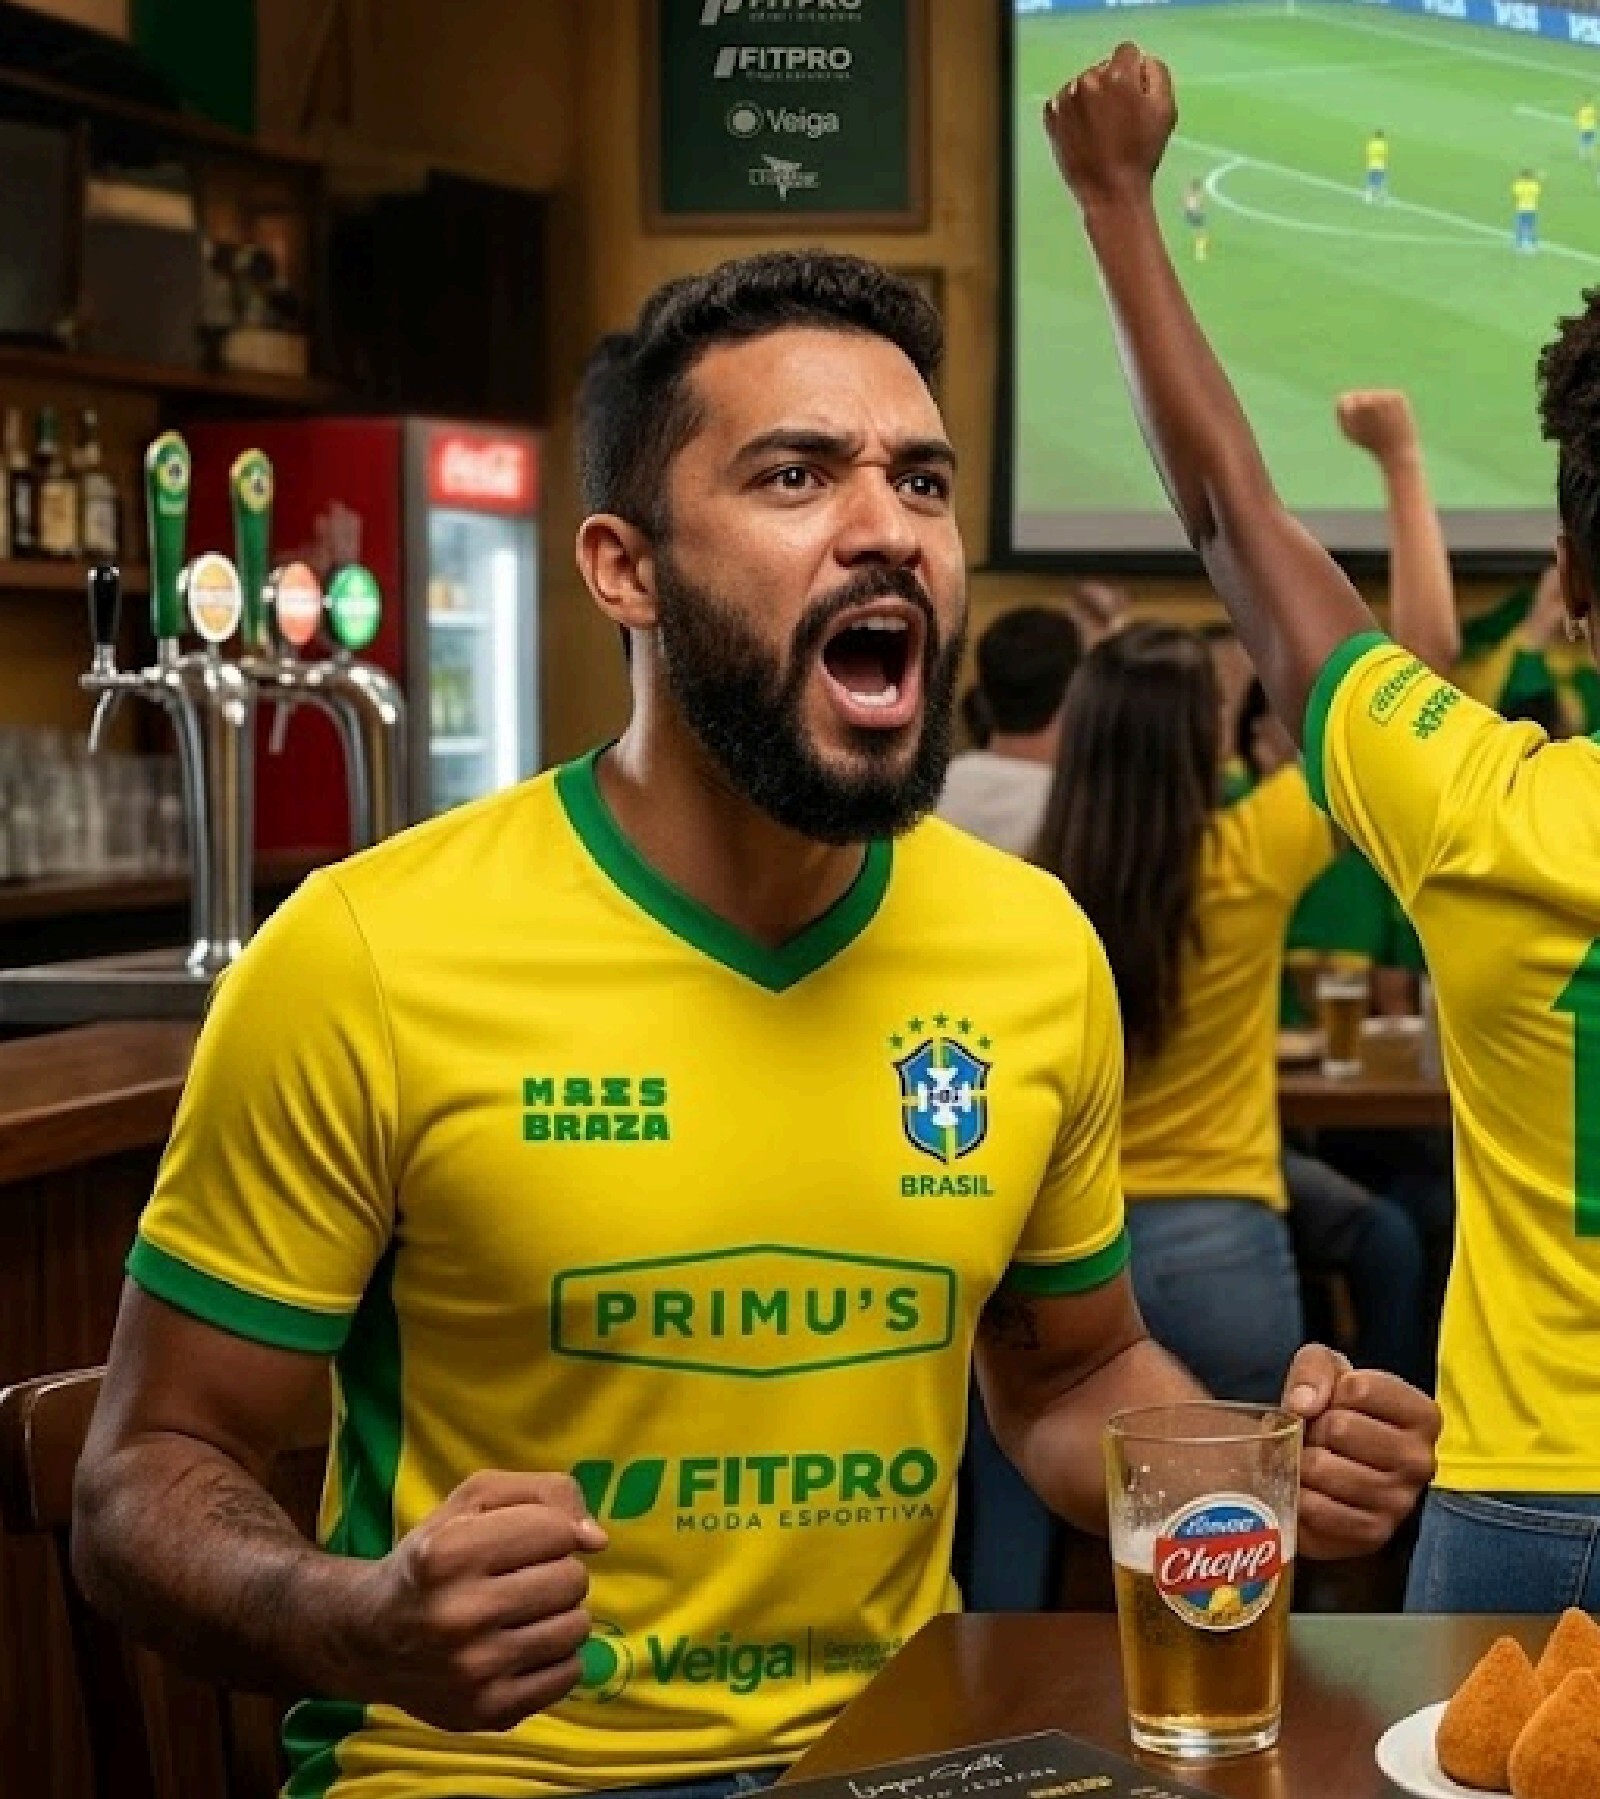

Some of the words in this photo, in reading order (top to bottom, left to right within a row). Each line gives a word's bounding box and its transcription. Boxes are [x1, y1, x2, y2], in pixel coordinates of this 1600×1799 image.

[738, 47, 852, 70] FITPRO
[765, 107, 840, 138] Veiga
[523, 1113, 671, 1141] BRAZA
[900, 1175, 994, 1198] BRASIL
[595, 1287, 920, 1338] PRIMU'S
[678, 1447, 938, 1508] FITPRO
[676, 1512, 762, 1532] MODA
[779, 1502, 934, 1530] ESPORTIVA
[646, 1632, 796, 1693] Veiga
